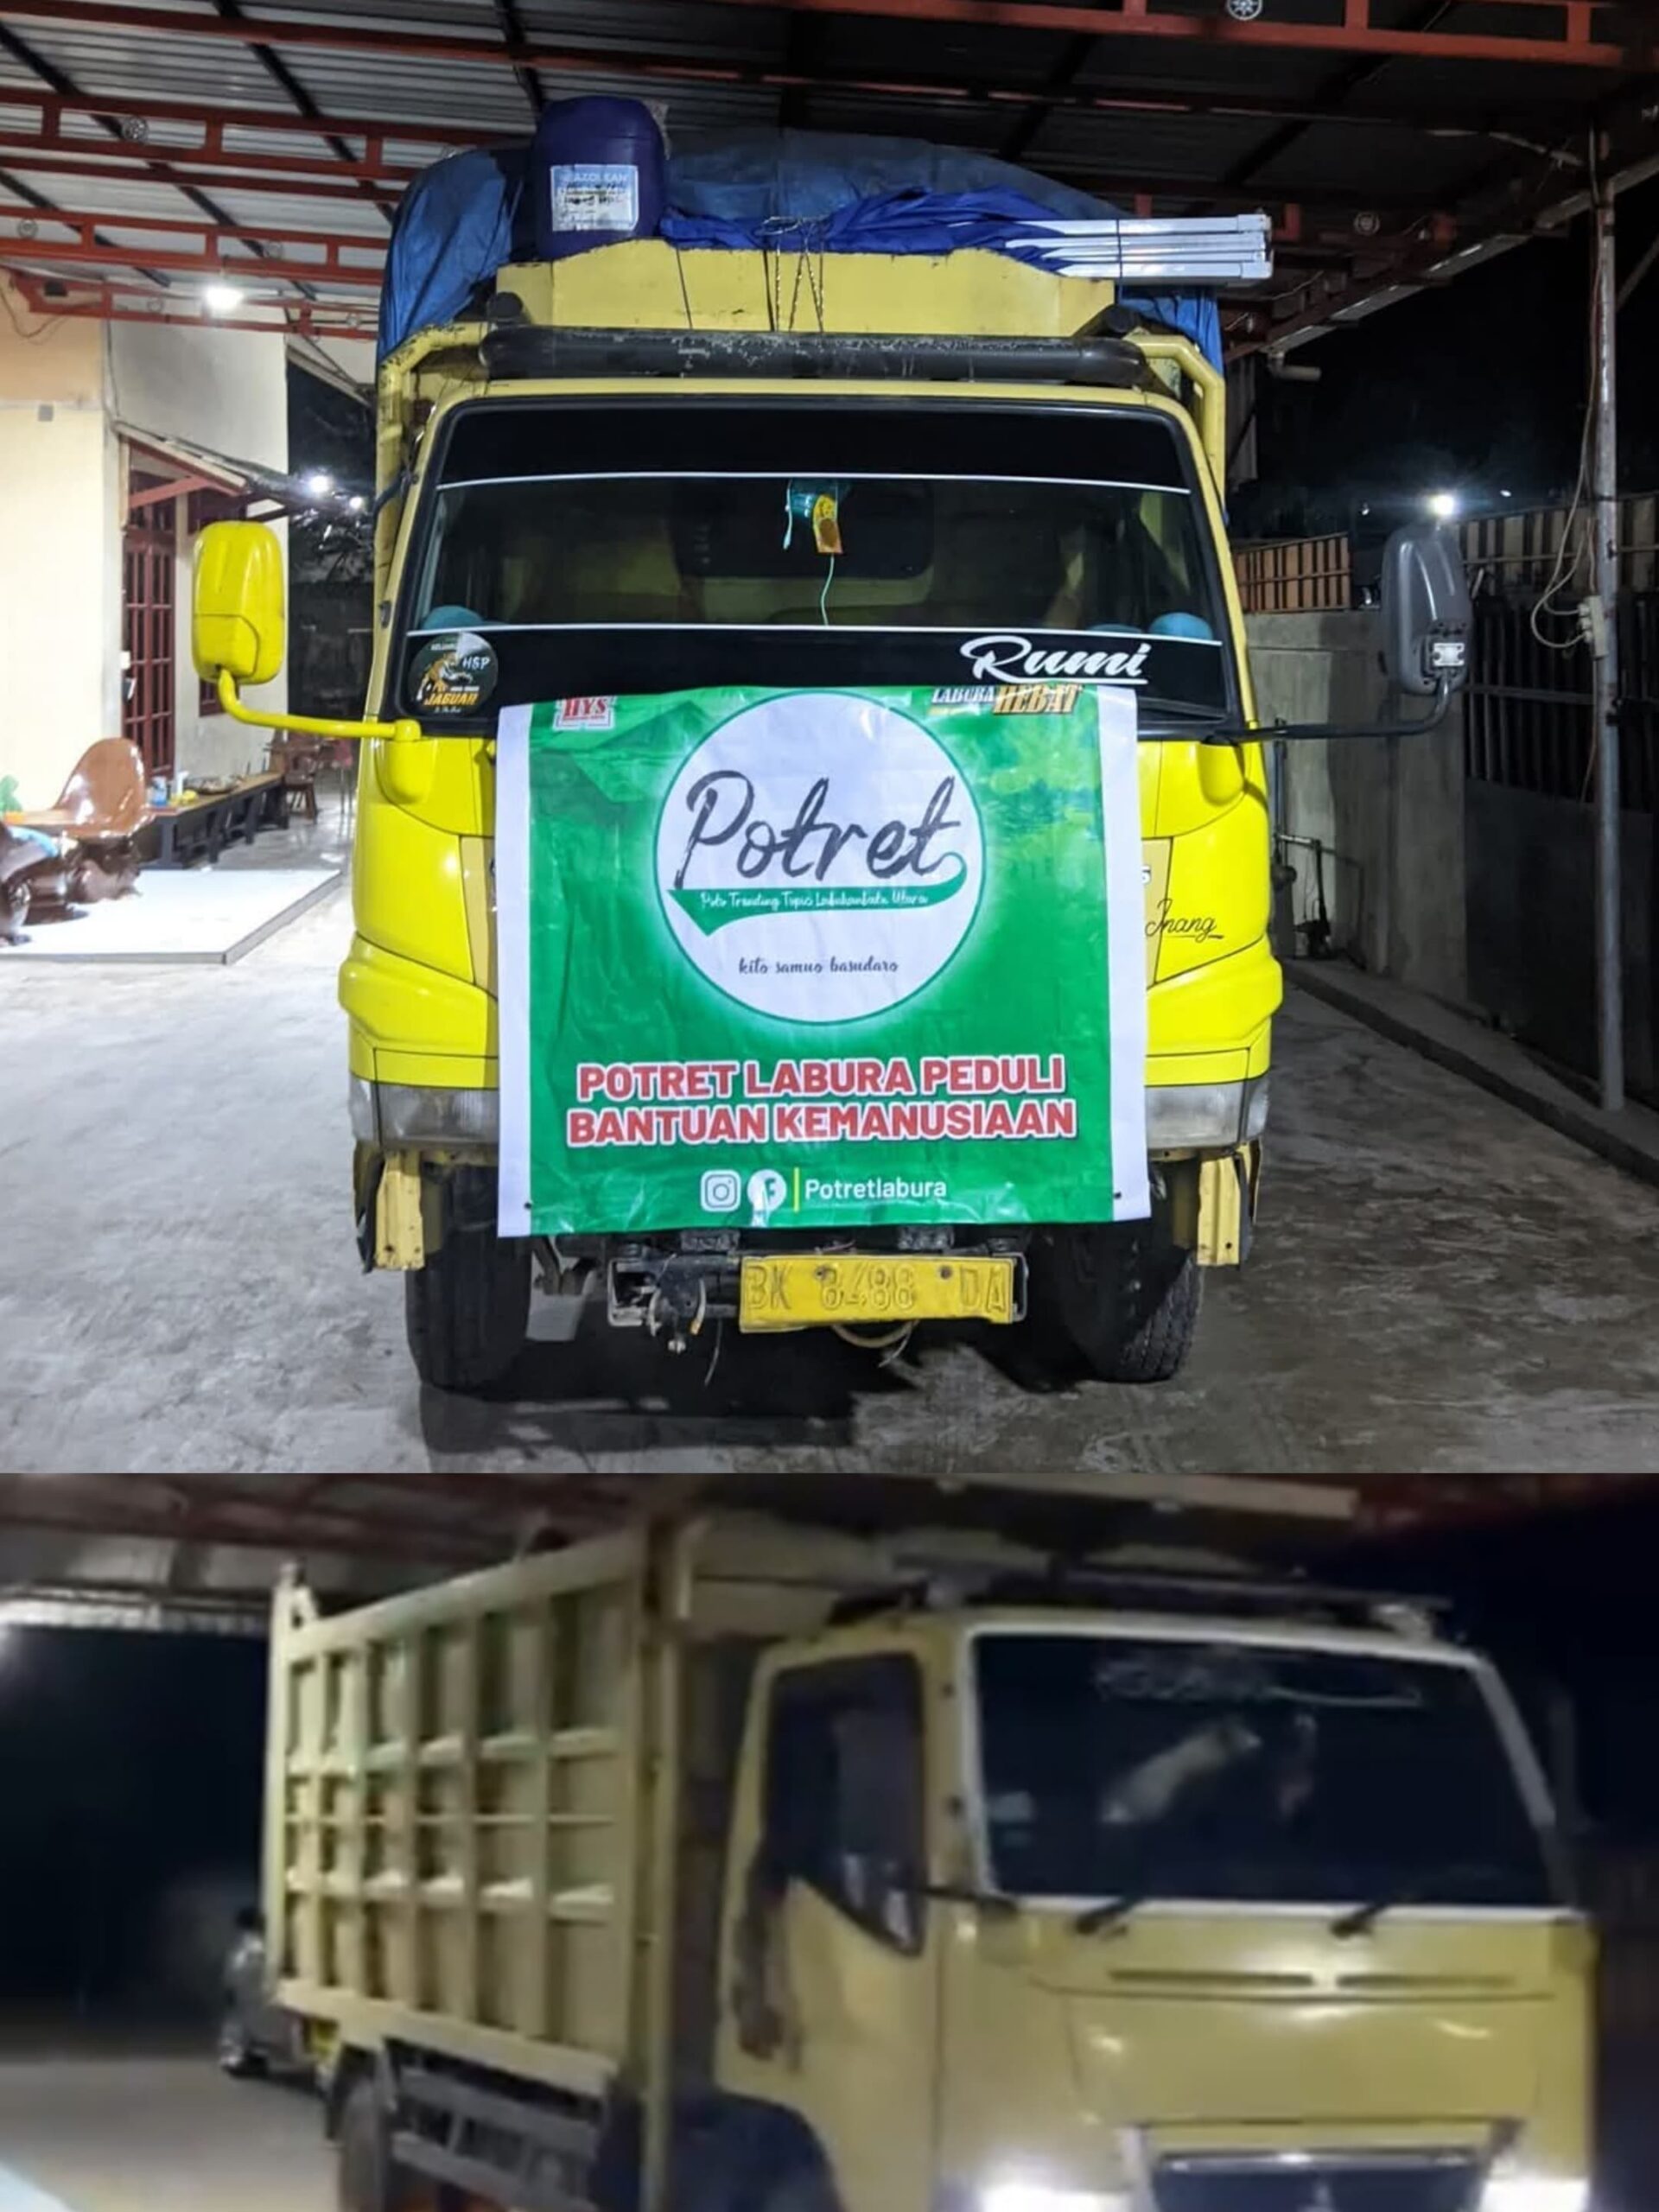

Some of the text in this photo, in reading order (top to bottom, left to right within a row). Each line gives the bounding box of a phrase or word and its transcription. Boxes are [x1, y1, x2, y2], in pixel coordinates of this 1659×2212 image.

[462, 657, 491, 670] HSP
[960, 635, 1151, 685] Rumi
[993, 684, 1081, 714] HEBAT
[673, 770, 961, 890] Potret
[739, 957, 769, 974] kito
[576, 1053, 1065, 1102] POTRET LABURA PEDULI
[567, 1098, 1077, 1147] BANTUAN KEMANUSIAAN
[804, 1176, 947, 1201] Potretlabura
[745, 1263, 791, 1310] BK
